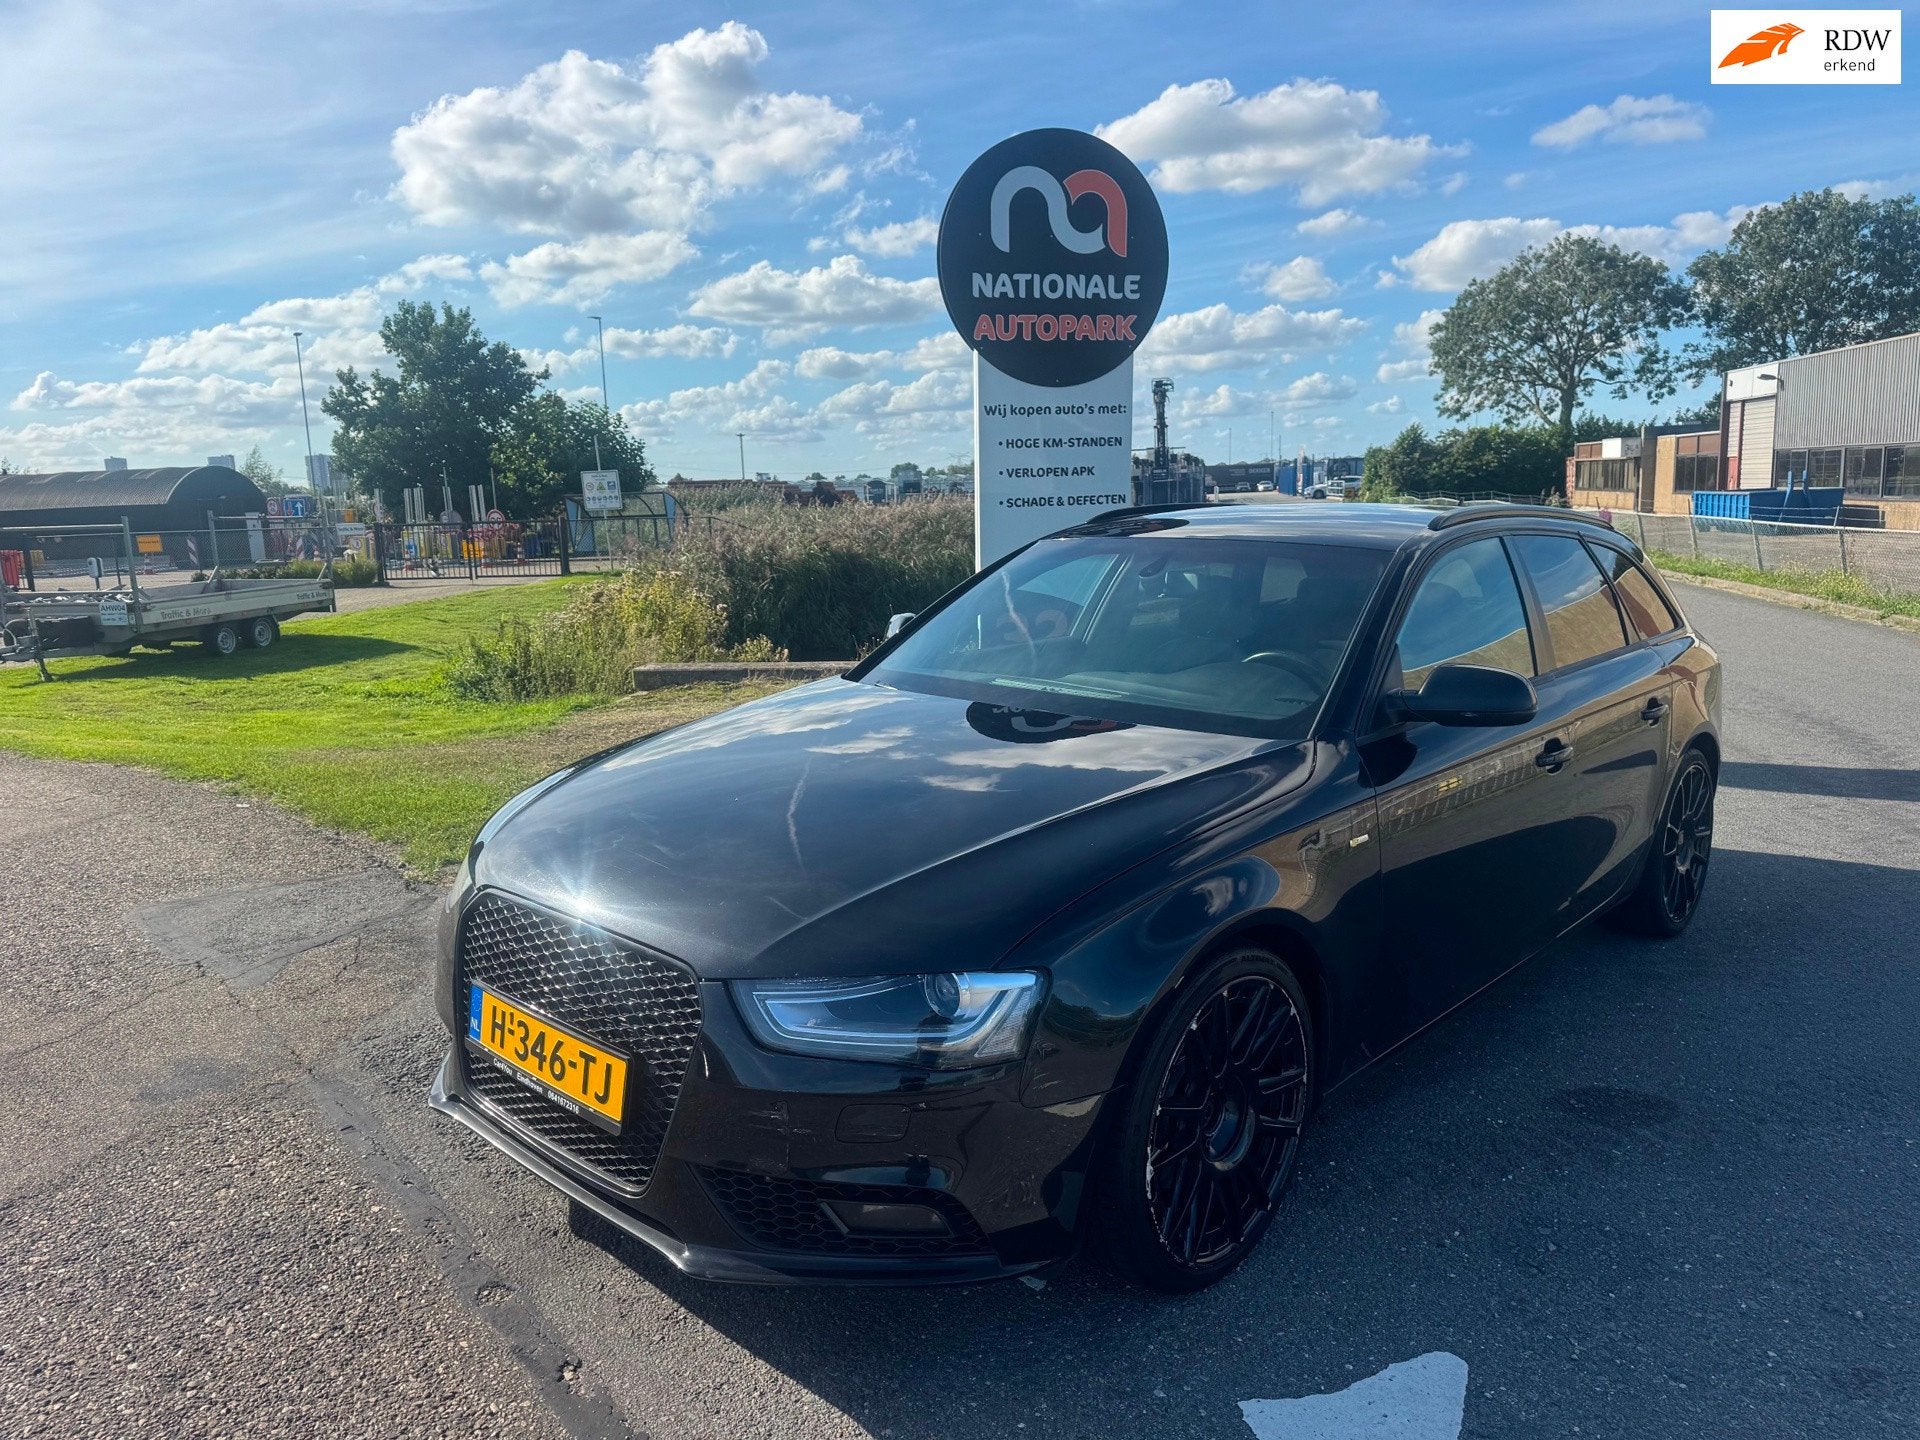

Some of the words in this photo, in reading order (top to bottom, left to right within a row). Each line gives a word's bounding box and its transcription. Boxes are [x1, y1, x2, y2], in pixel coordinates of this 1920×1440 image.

[972, 272, 1141, 300] NATIONALE
[973, 313, 1138, 341] AUTOPARK
[984, 404, 1007, 418] Wij
[1010, 404, 1051, 418] kopen
[1055, 403, 1095, 415] auto's
[1097, 403, 1127, 414] met:
[1006, 438, 1040, 449] HOGE
[1043, 436, 1123, 448] KM-STANDEN
[1006, 467, 1069, 478] VERLOPEN
[1071, 466, 1095, 476] APK
[1006, 497, 1055, 508] SCHADE
[1057, 497, 1065, 507] &
[1068, 494, 1126, 506] DEFECTEN
[470, 1017, 480, 1032] NL
